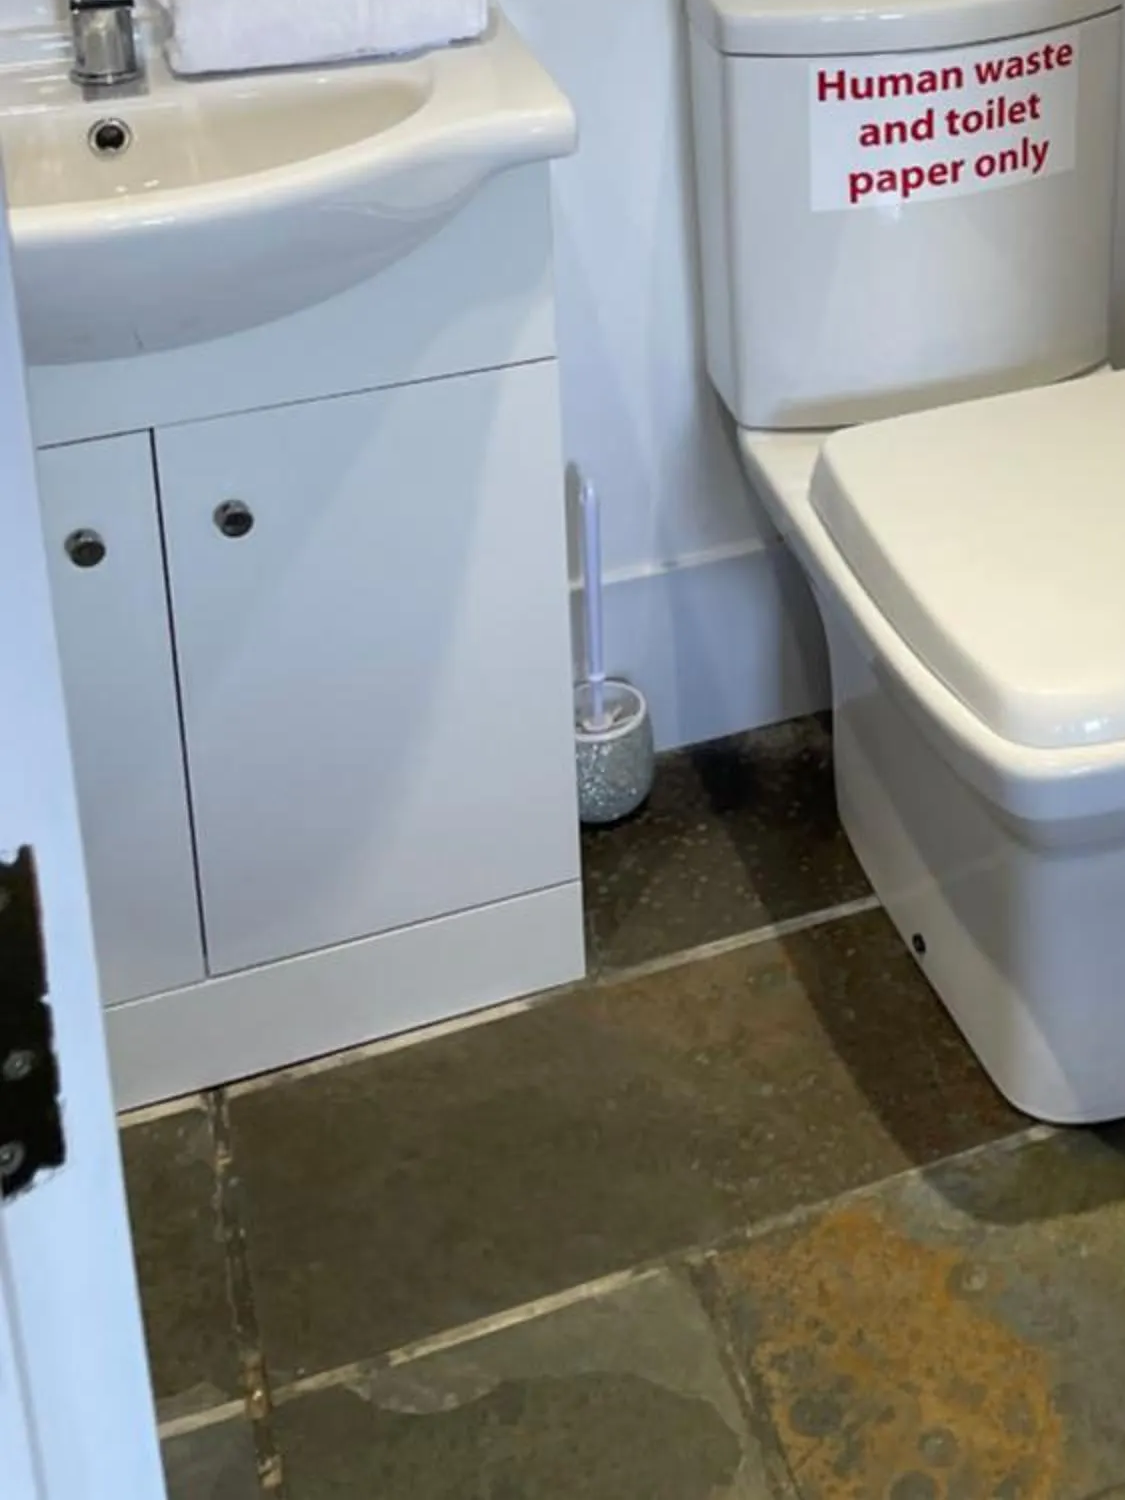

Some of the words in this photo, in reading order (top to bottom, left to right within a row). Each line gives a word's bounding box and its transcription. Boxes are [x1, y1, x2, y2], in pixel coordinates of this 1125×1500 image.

[817, 66, 964, 102] Human
[974, 43, 1073, 84] waste
[859, 107, 935, 147] and
[945, 92, 1041, 136] toilet
[848, 159, 965, 203] paper
[974, 136, 1050, 178] only
